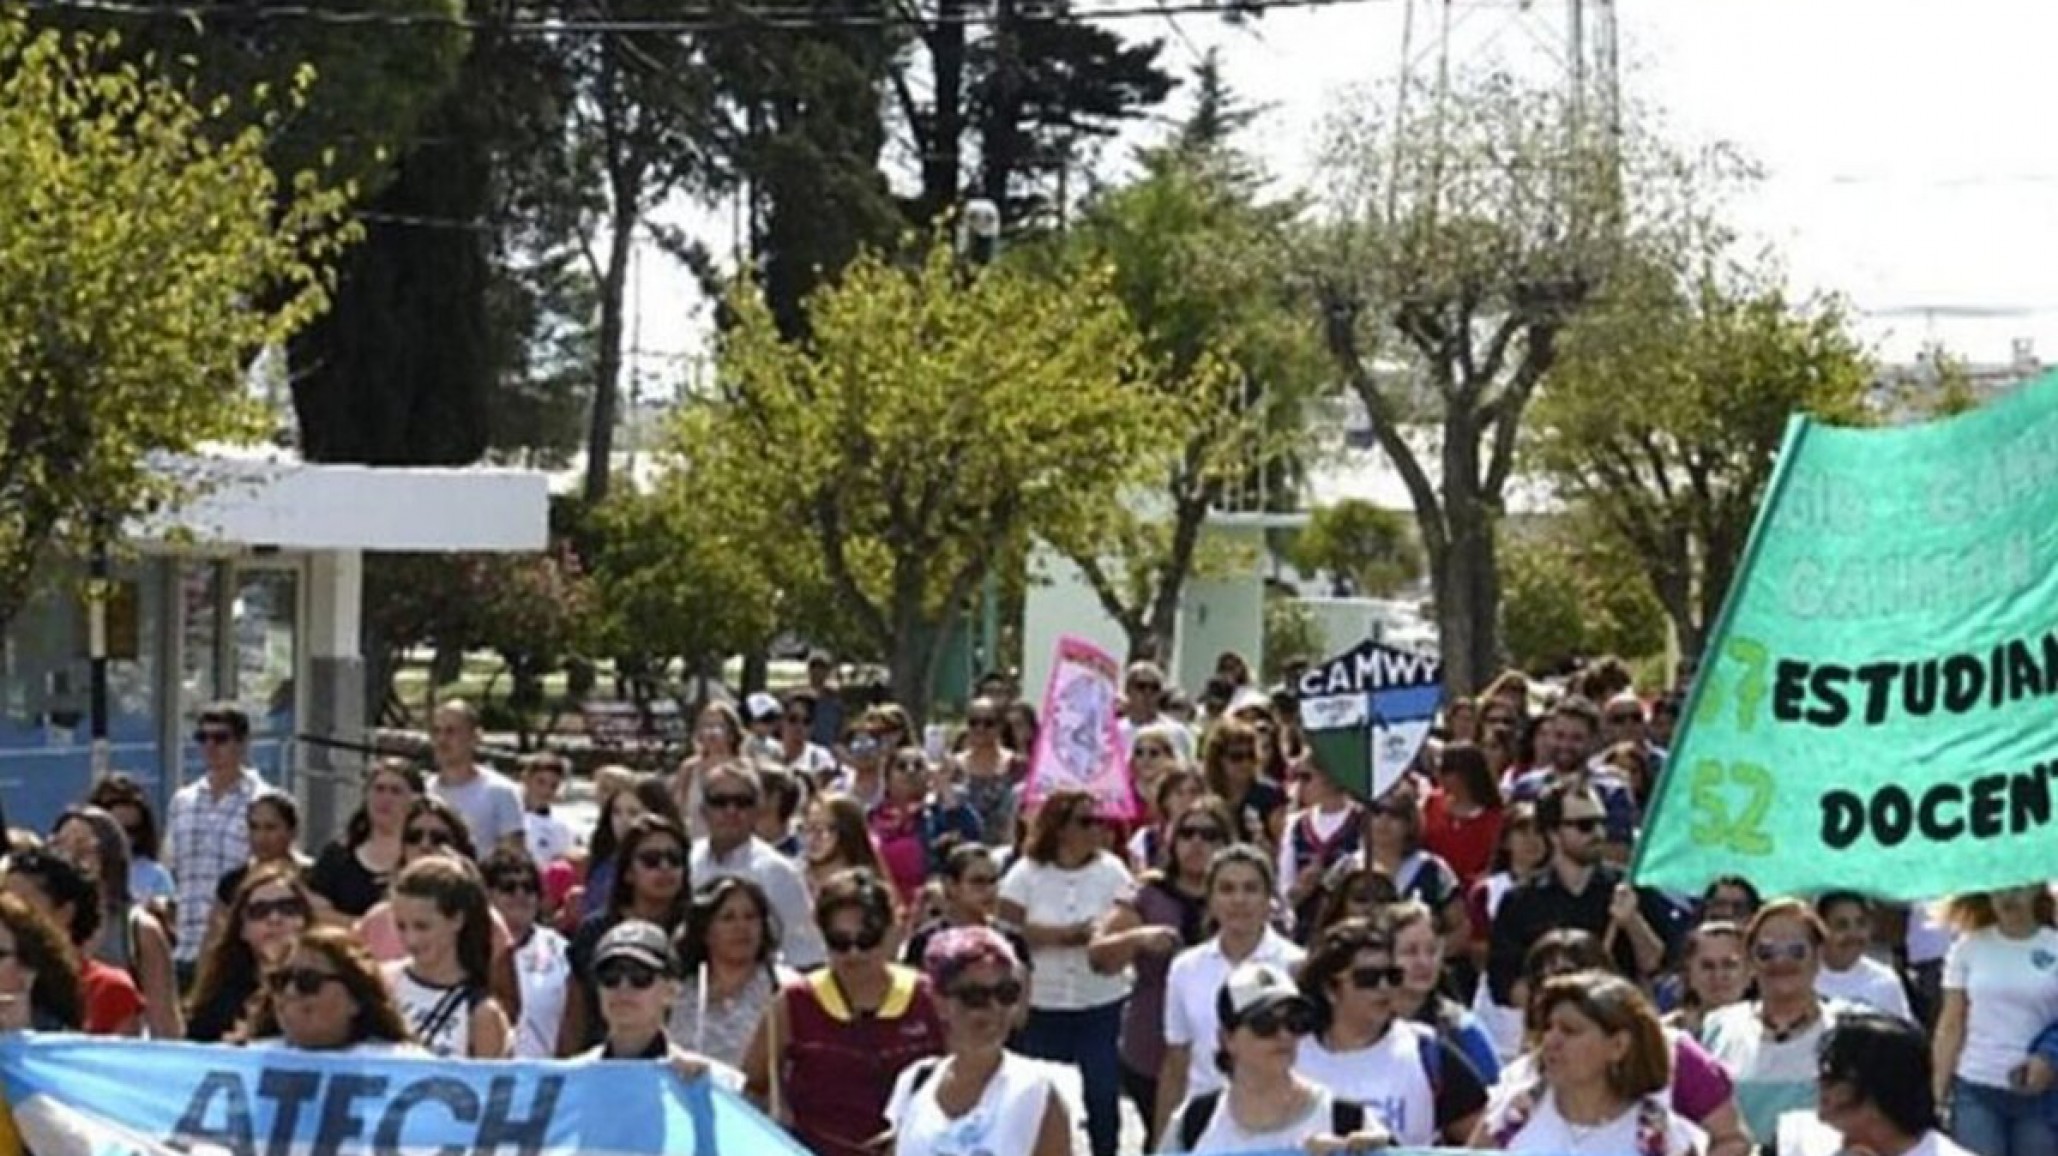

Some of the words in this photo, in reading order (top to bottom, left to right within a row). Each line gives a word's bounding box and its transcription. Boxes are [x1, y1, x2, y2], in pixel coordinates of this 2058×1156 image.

[1300, 648, 1438, 693] CAMWY
[1690, 759, 1774, 855] 52
[1820, 758, 2058, 849] DOCEN
[165, 1066, 566, 1156] ATECH
